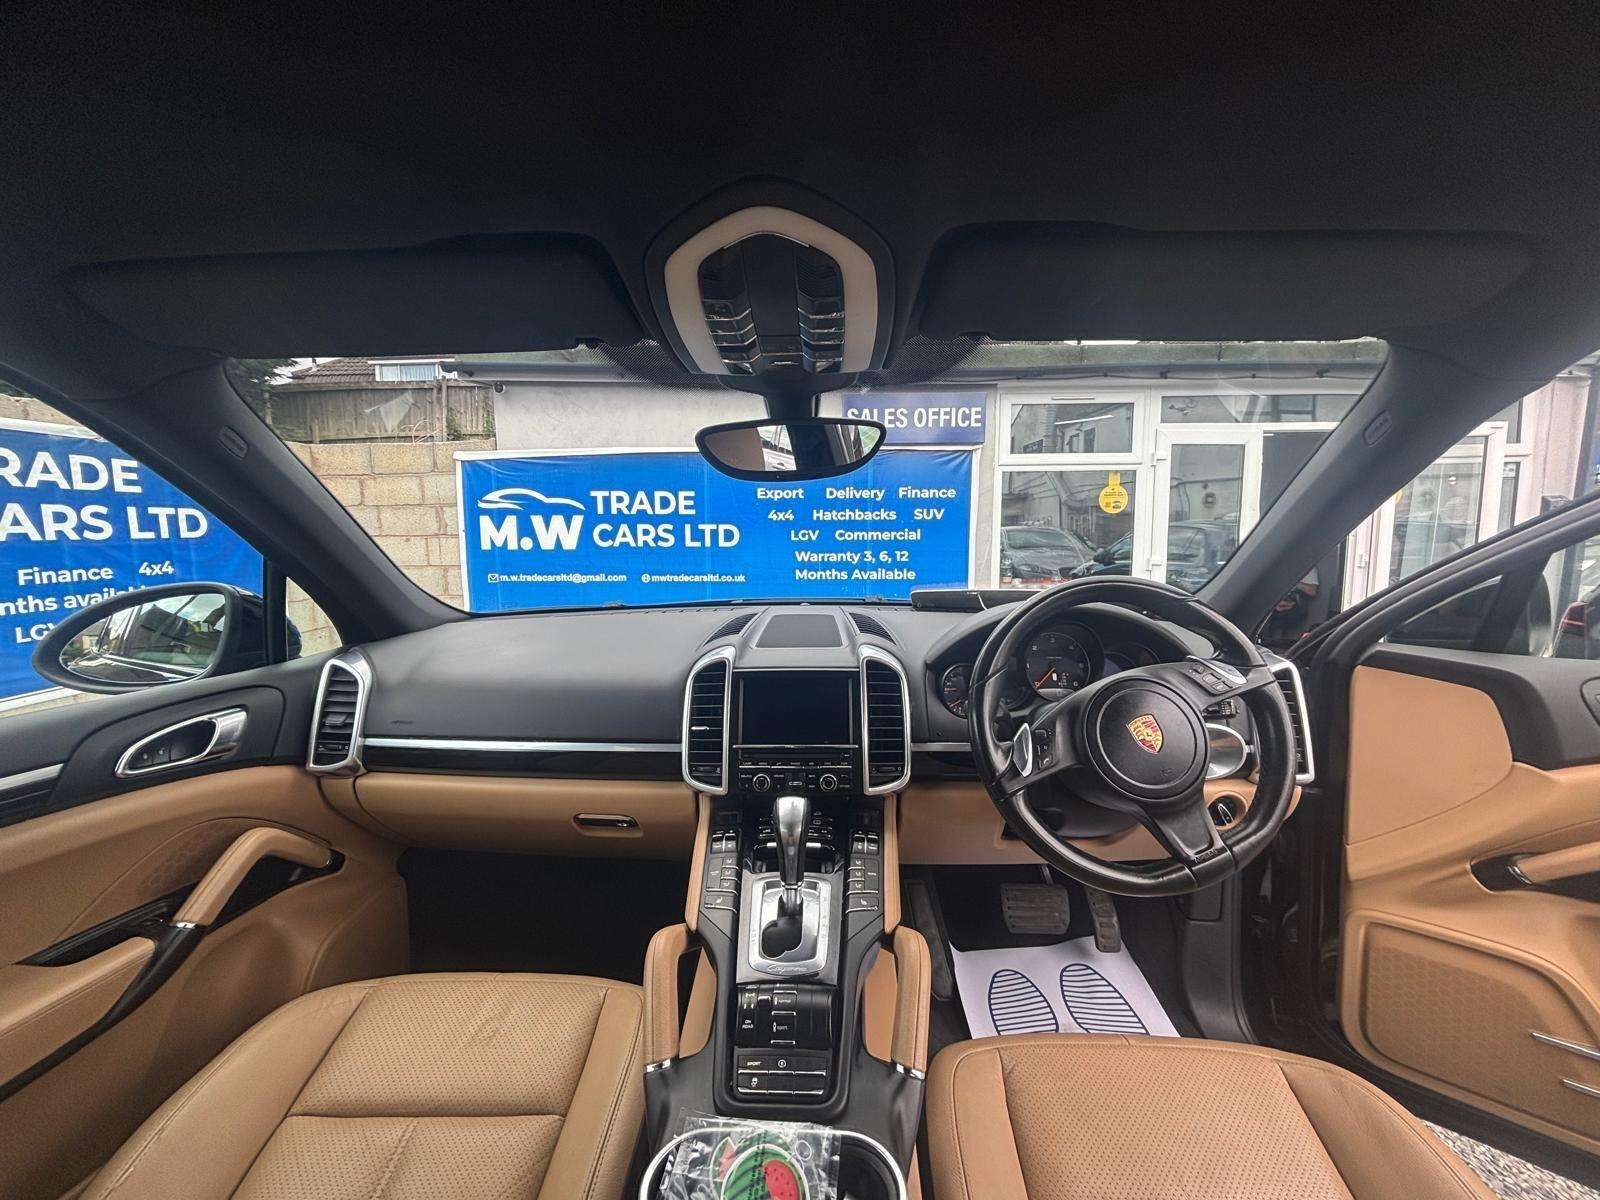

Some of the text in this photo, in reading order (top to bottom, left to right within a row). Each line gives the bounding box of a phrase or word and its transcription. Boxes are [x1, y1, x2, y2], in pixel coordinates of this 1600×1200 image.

[913, 406, 982, 428] OFFICE
[589, 490, 696, 515] TRADE
[757, 486, 957, 501] Export Delivery Finance
[0, 502, 208, 542] ARS LTD
[767, 508, 945, 521] 4x4 Hatchbacks SUV
[479, 514, 584, 551] M.W
[592, 523, 740, 548] CARS LTD
[790, 528, 921, 541] LGV Commercial
[795, 550, 909, 564] Warranty 3, 6, 12
[17, 560, 175, 586] Finance 4x4
[499, 573, 627, 584] m.w.tradecarsltd@gmail.com
[651, 573, 746, 583] mwtradecarsltd.co.uk
[795, 567, 916, 580] Months Available
[15, 622, 55, 643] LG
